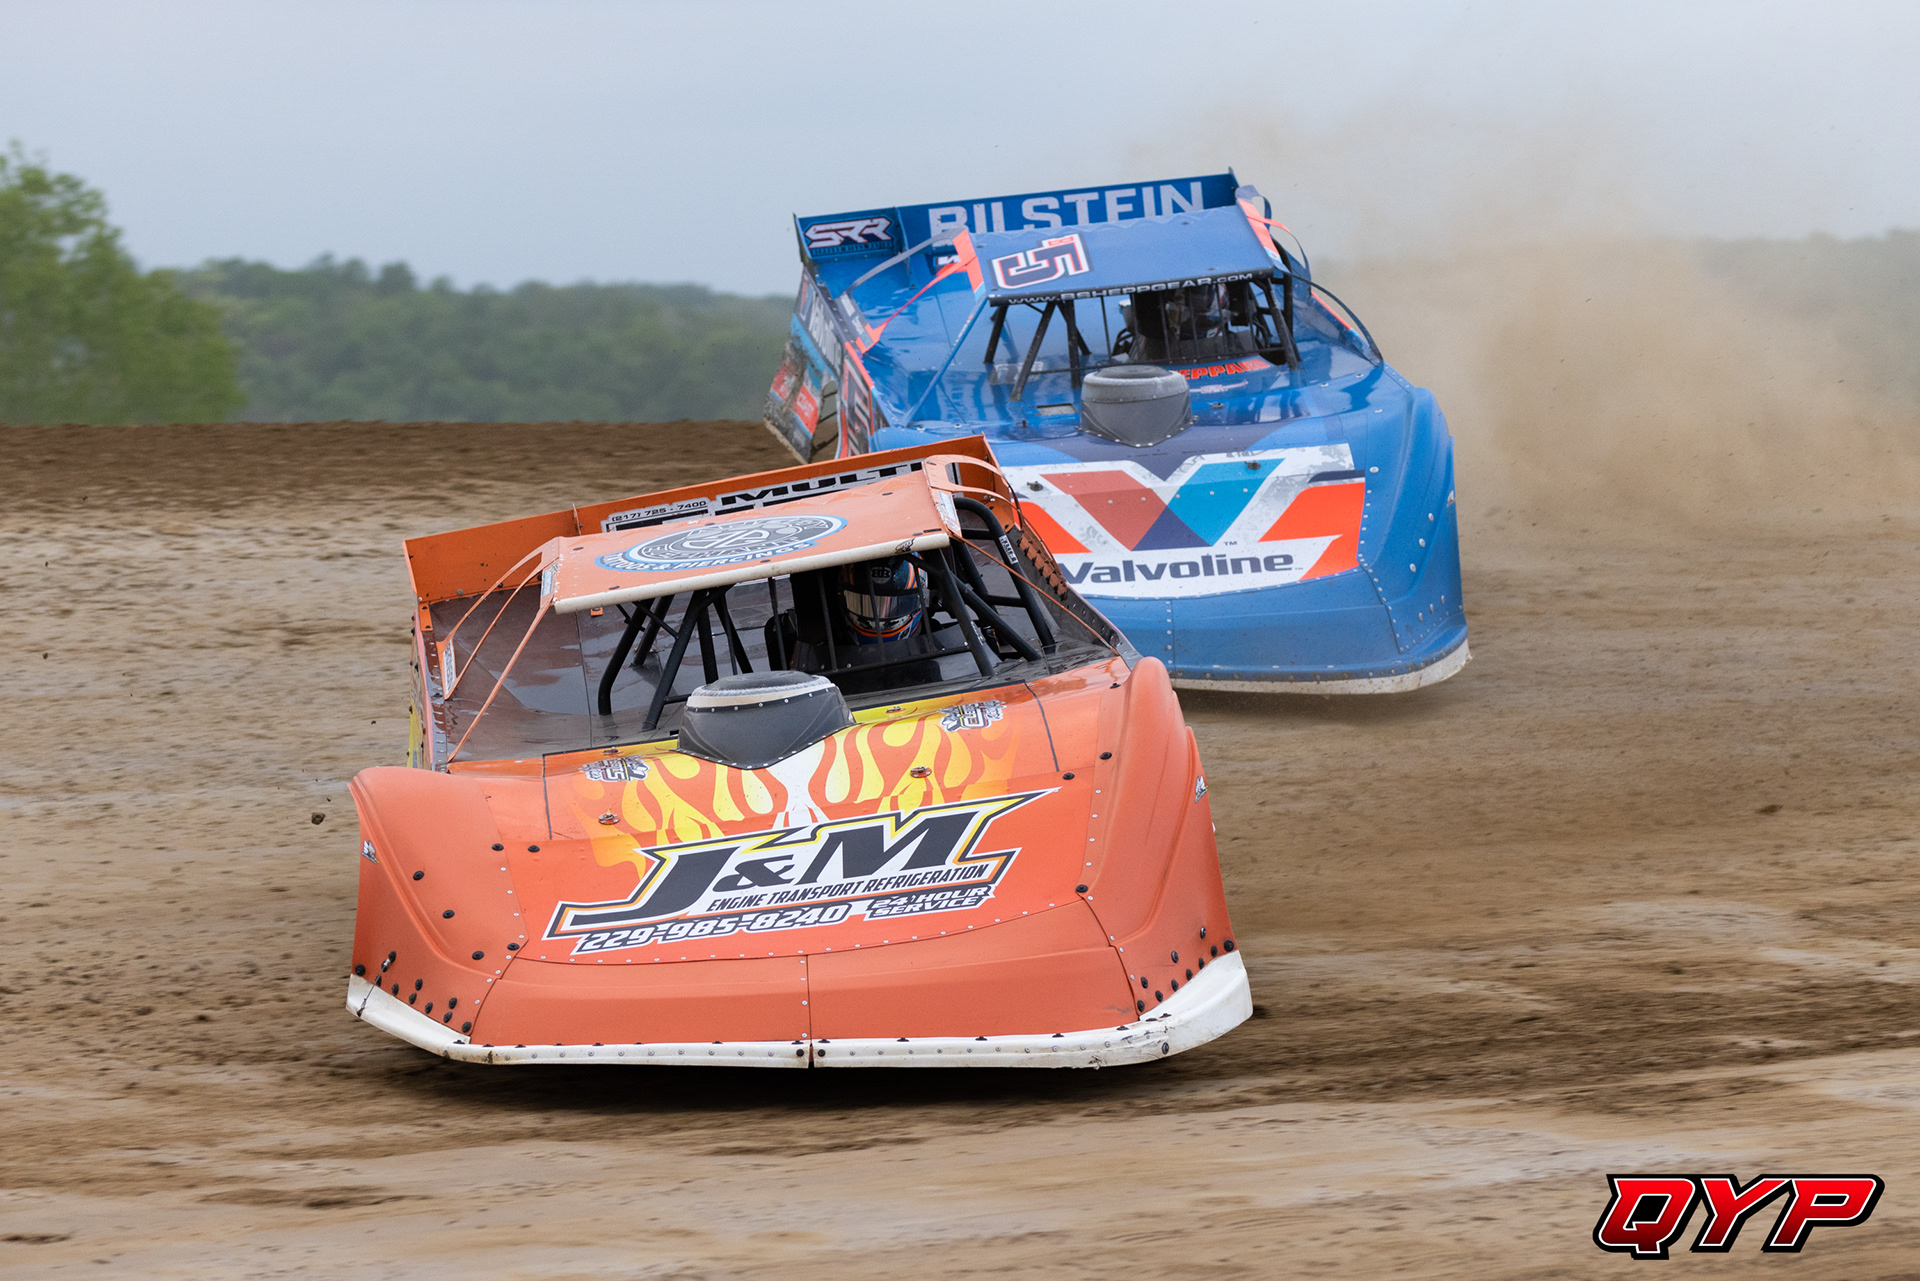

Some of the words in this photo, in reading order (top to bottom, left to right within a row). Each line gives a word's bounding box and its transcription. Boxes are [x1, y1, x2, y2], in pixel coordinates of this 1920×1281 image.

[804, 217, 894, 250] SRR
[1175, 359, 1271, 380] EPPARD
[611, 512, 640, 522] (217)
[644, 507, 667, 516] 725
[677, 500, 707, 510] 7400
[601, 552, 651, 571] TATTOOS
[673, 542, 811, 569] PIERCINGS
[1057, 553, 1294, 585] Valvoline
[568, 811, 980, 927] J&M
[706, 893, 768, 912] ENGINE
[771, 881, 865, 905] TRANSPORT
[862, 864, 989, 893] REFRIGERATION
[871, 896, 909, 909] 24
[915, 886, 990, 904] HOUR
[873, 896, 980, 917] SERVICE
[580, 903, 848, 951] 229-985-8240
